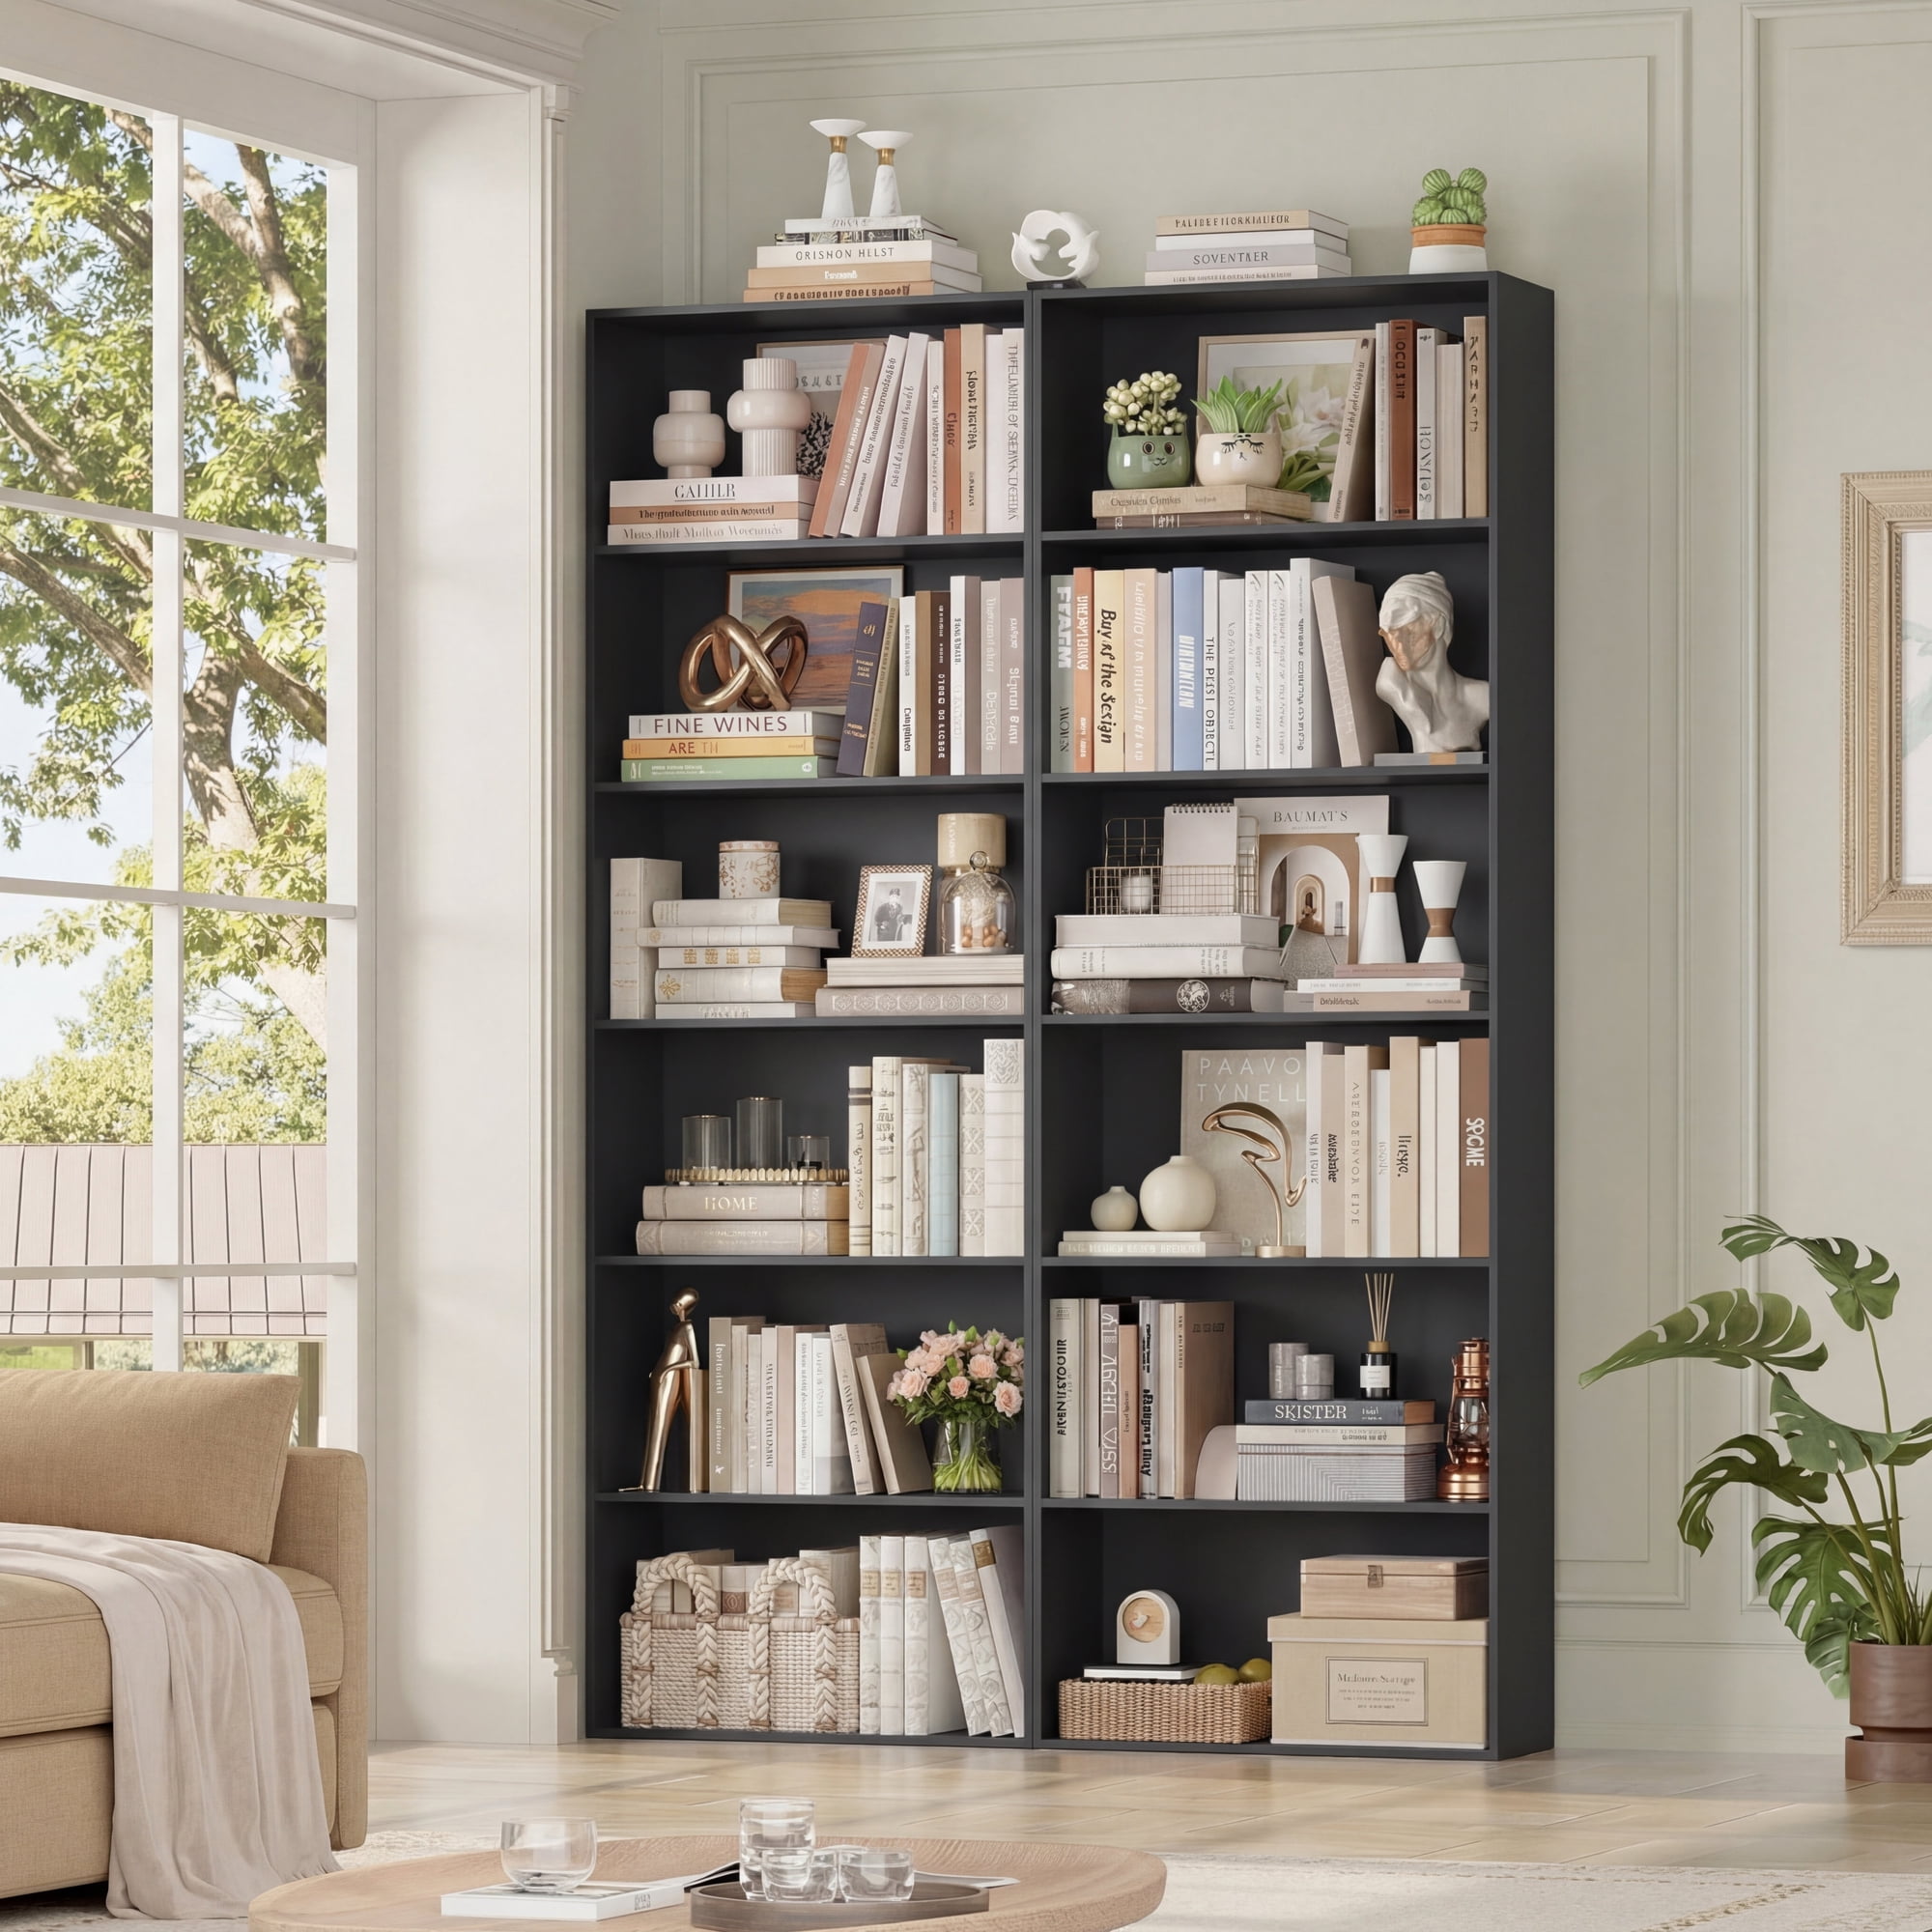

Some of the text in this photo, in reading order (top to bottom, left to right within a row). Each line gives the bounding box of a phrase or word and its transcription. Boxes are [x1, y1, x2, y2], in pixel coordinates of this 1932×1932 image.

[1097, 609, 1117, 639] Buy
[1100, 663, 1117, 689] the
[654, 716, 788, 734] FINE WINES
[668, 742, 696, 753] ARE
[1200, 1057, 1301, 1075] PAAVO
[1197, 1083, 1306, 1102] TYNELL
[1274, 1405, 1348, 1422] SKISTER
